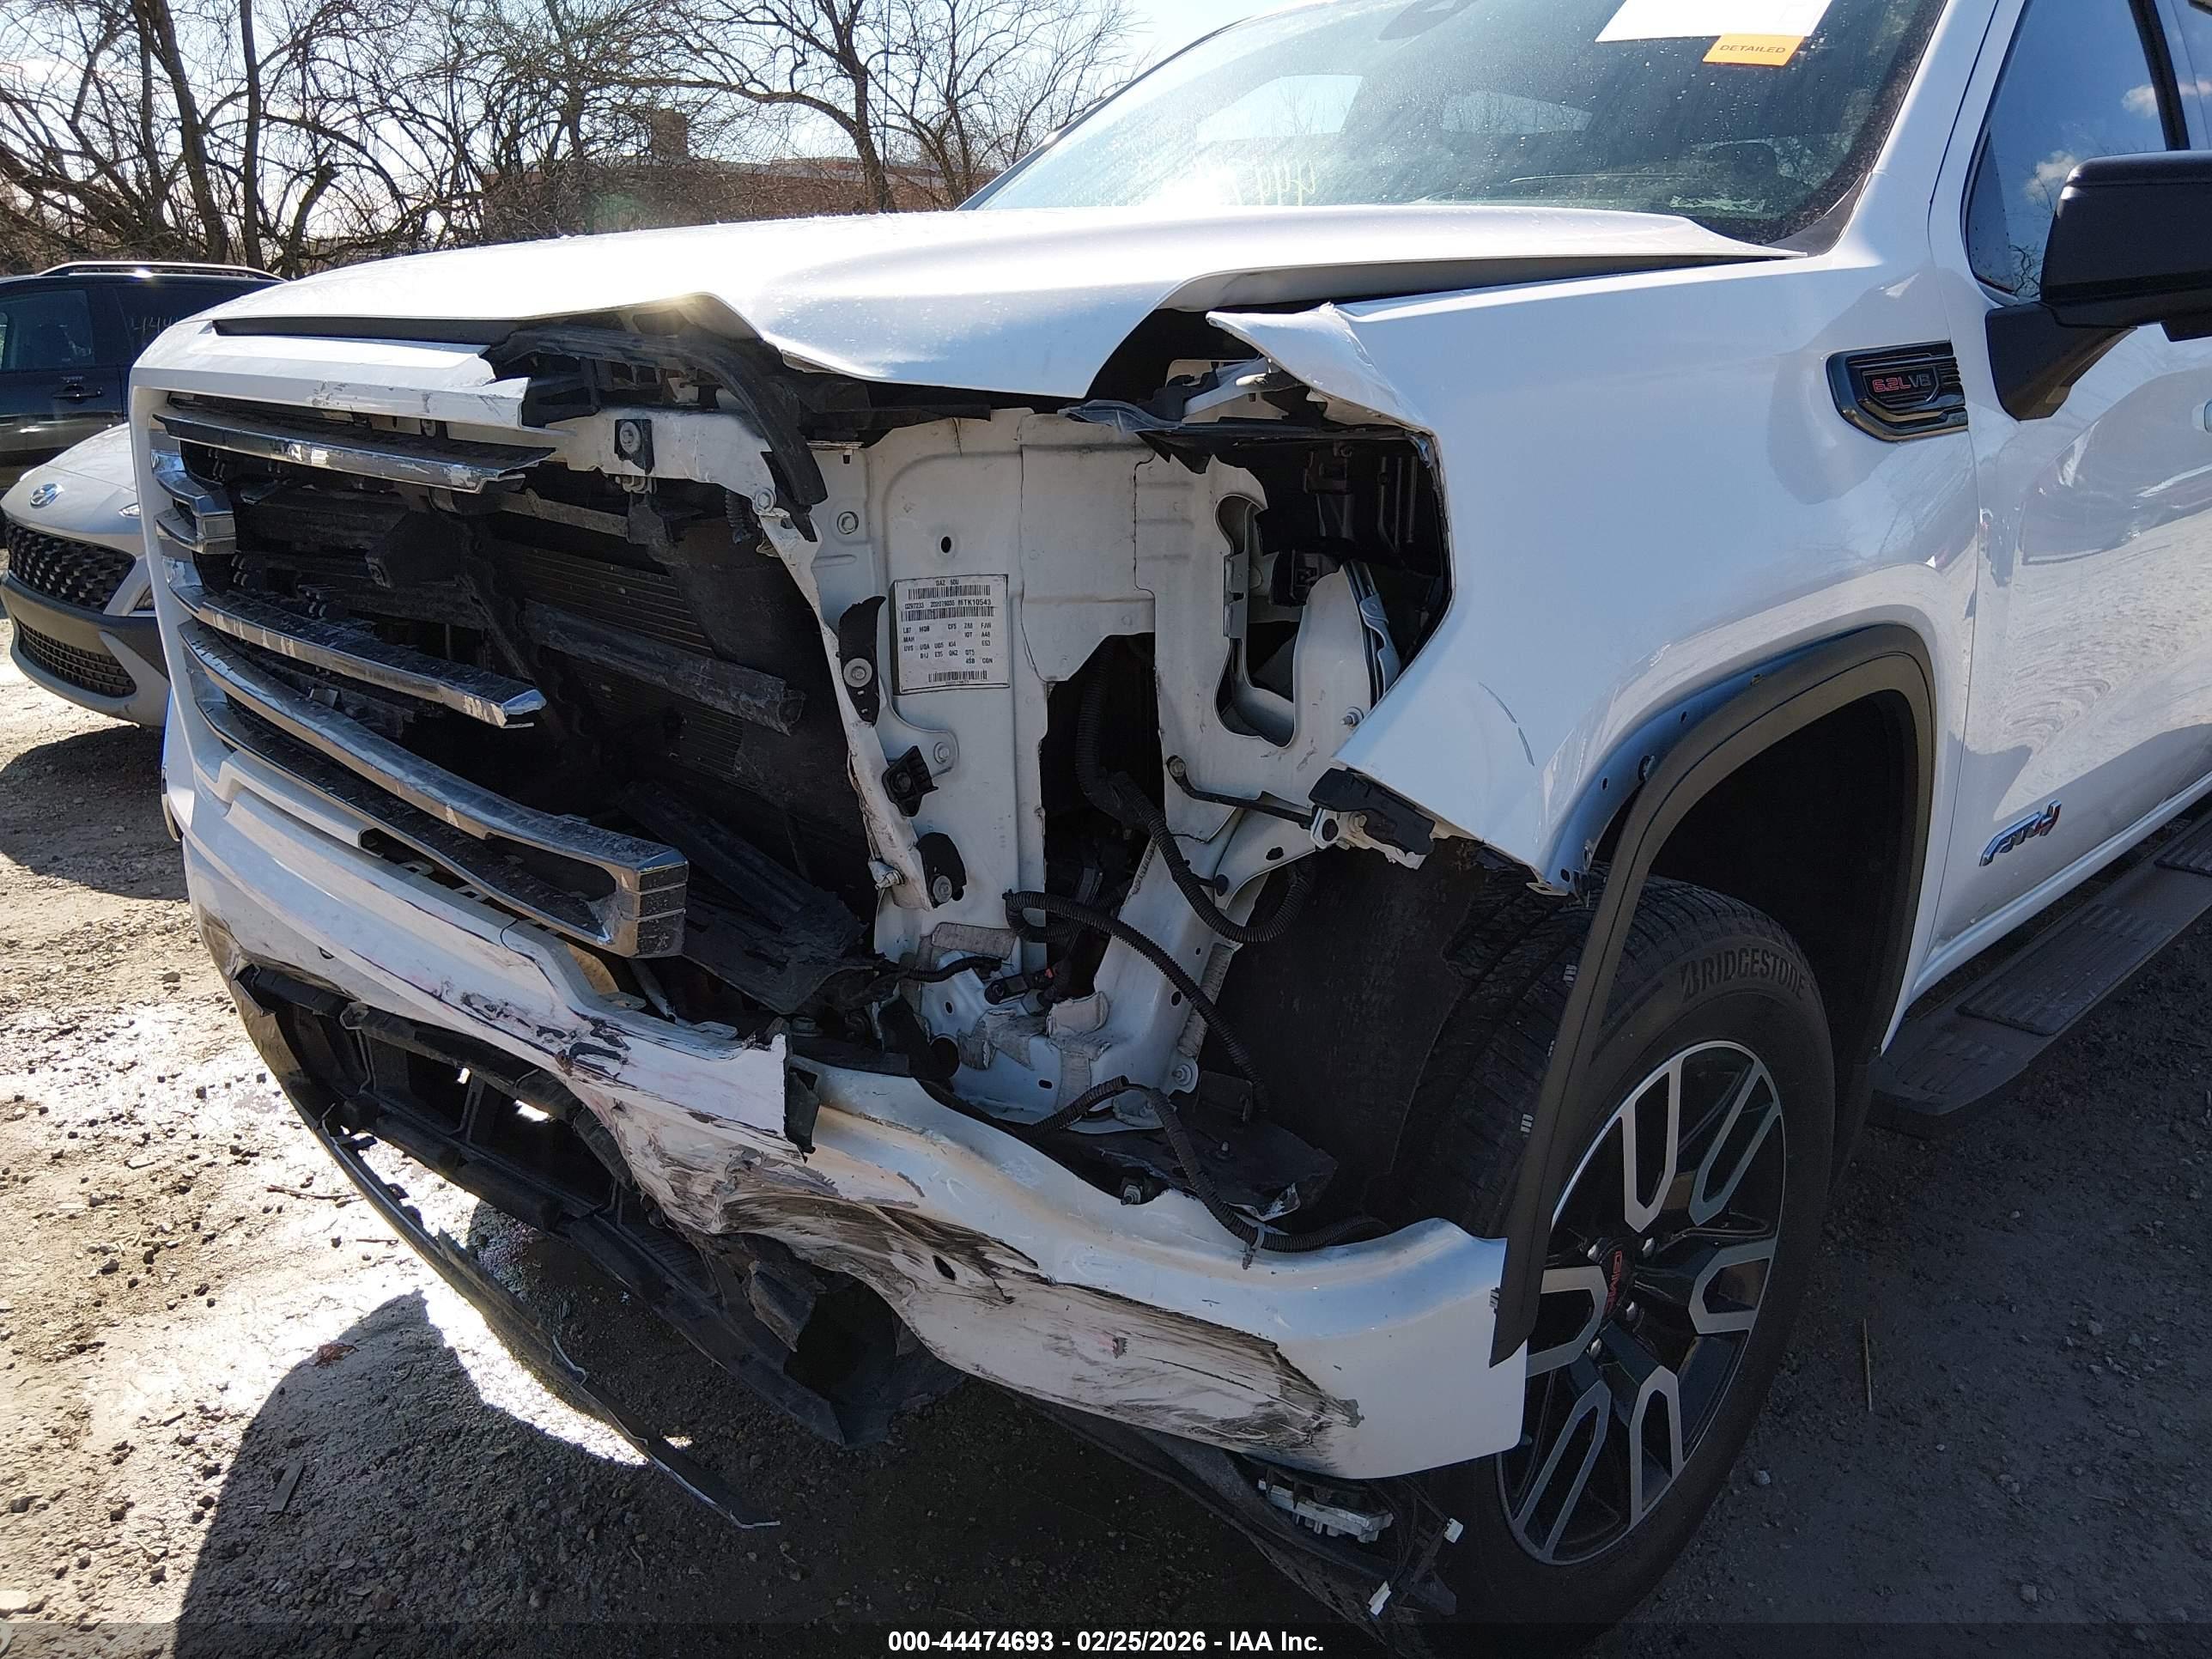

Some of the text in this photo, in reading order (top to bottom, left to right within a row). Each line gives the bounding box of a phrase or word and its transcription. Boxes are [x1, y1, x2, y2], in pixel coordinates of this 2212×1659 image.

[1719, 44, 1787, 54] DETAILED
[1680, 947, 1806, 1003] BRIDGESTONE
[1605, 1249, 1623, 1316] GMC
